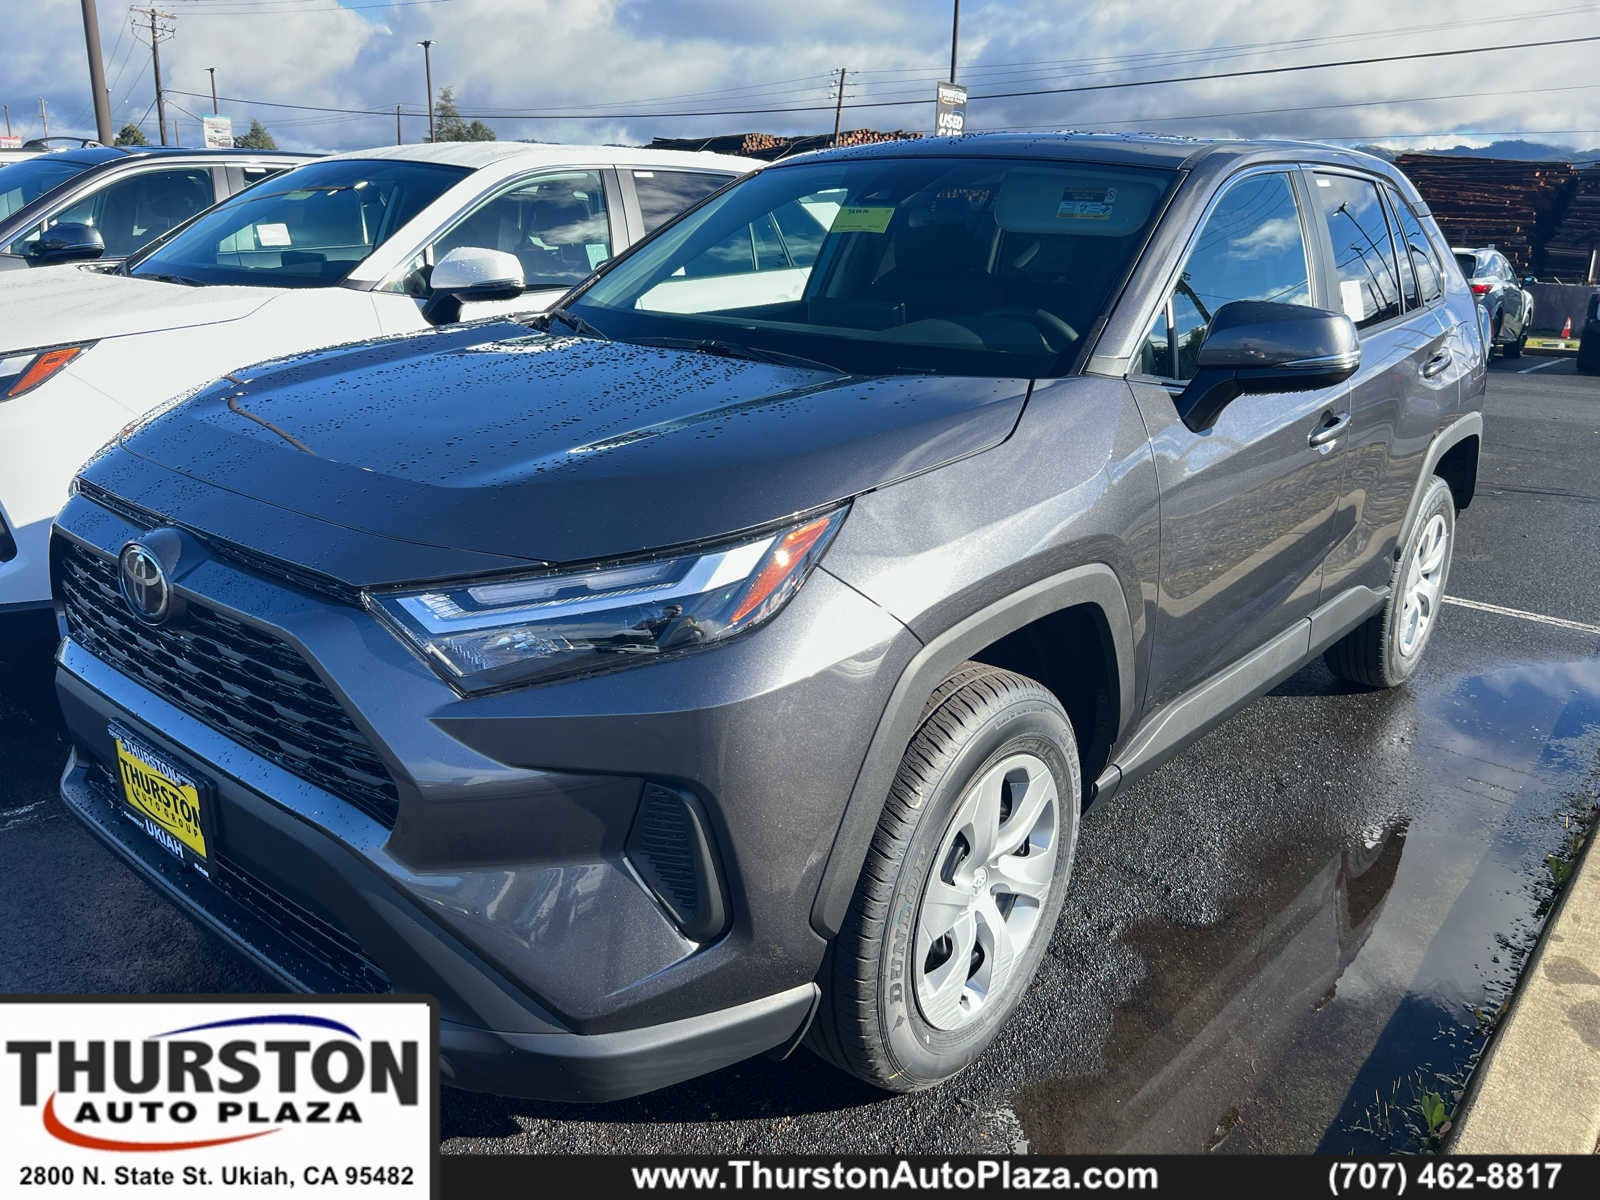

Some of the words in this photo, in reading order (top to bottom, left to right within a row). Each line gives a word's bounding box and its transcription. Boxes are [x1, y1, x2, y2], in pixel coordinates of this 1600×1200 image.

[939, 113, 964, 129] USED
[124, 739, 176, 781] THURSTON
[120, 757, 201, 829] THURSTON
[136, 789, 160, 811] AUTO
[164, 809, 198, 837] GROUP
[145, 819, 184, 859] UKIAH
